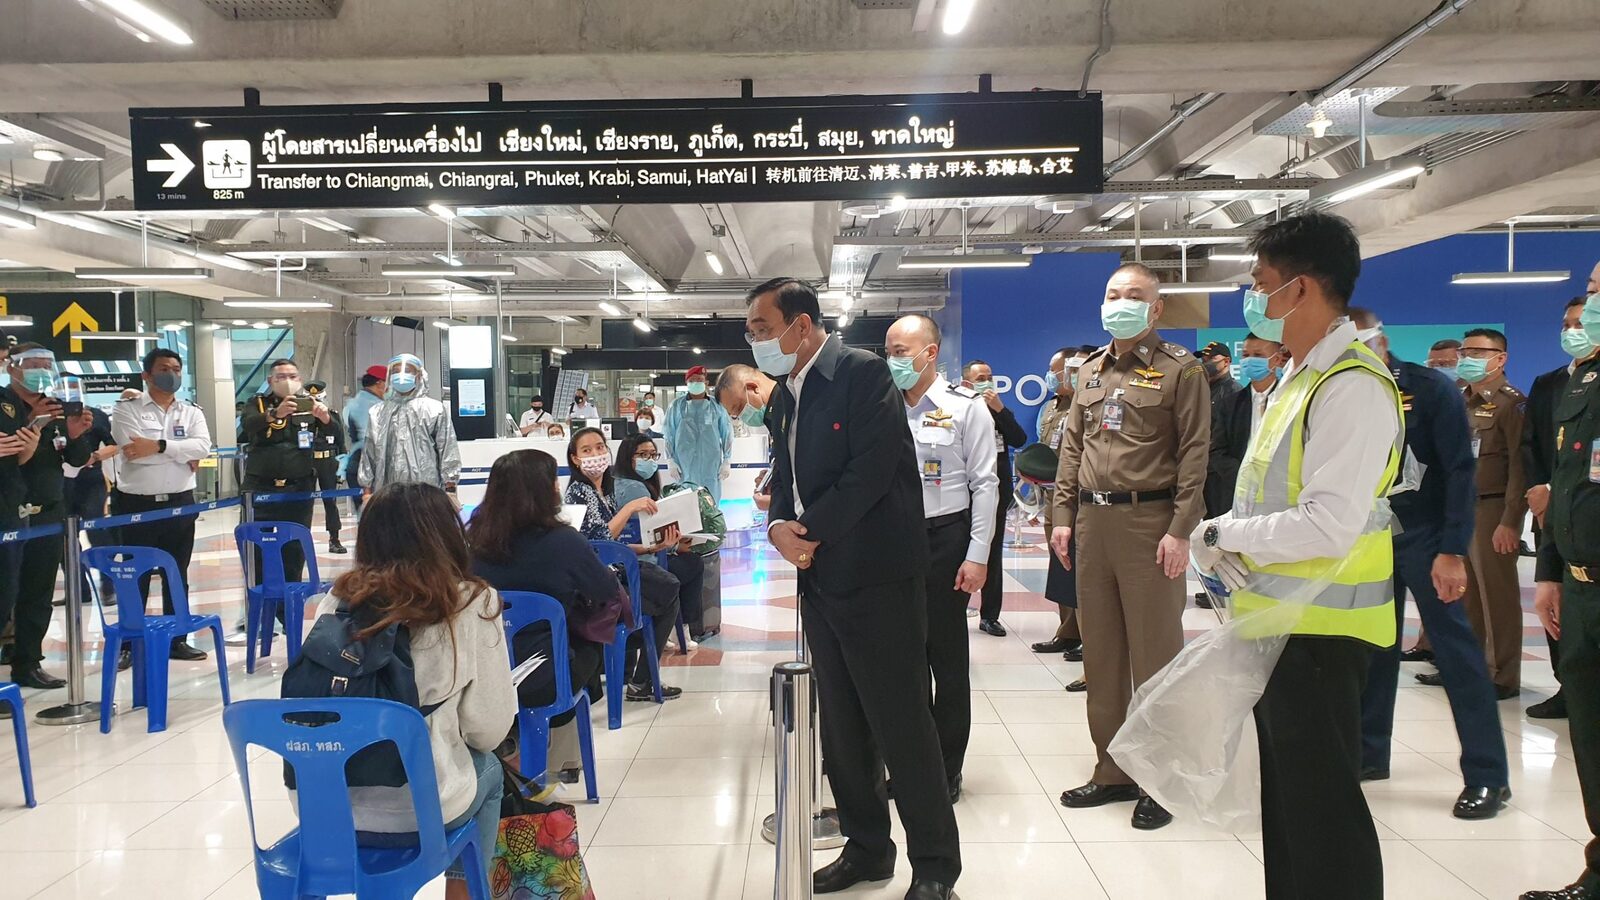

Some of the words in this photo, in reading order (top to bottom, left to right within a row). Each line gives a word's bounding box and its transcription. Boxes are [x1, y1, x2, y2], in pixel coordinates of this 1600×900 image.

[262, 124, 482, 163] ผู้โดยสารเปลี่ยนเครื่องไป
[499, 124, 588, 154] เชียงใหม่,
[595, 127, 679, 153] เชียงราย,
[688, 124, 744, 157] ภูเก็ต,
[753, 118, 809, 150] กระบี่,
[818, 130, 864, 154] สมุย,
[871, 116, 955, 149] หาดใหญ่
[257, 173, 323, 190] Transfer
[326, 175, 342, 189] to
[345, 172, 434, 192] Chiangmai,
[439, 171, 519, 191] Chiangrai,
[525, 170, 584, 189] Phuket,
[589, 170, 634, 188] Krabi,
[637, 169, 692, 187] Samui,
[697, 168, 748, 185] HatYai
[213, 189, 233, 200] 825
[234, 191, 245, 200] m
[256, 494, 270, 502] AOT
[84, 520, 96, 529] AOT
[3, 531, 19, 542] AOT
